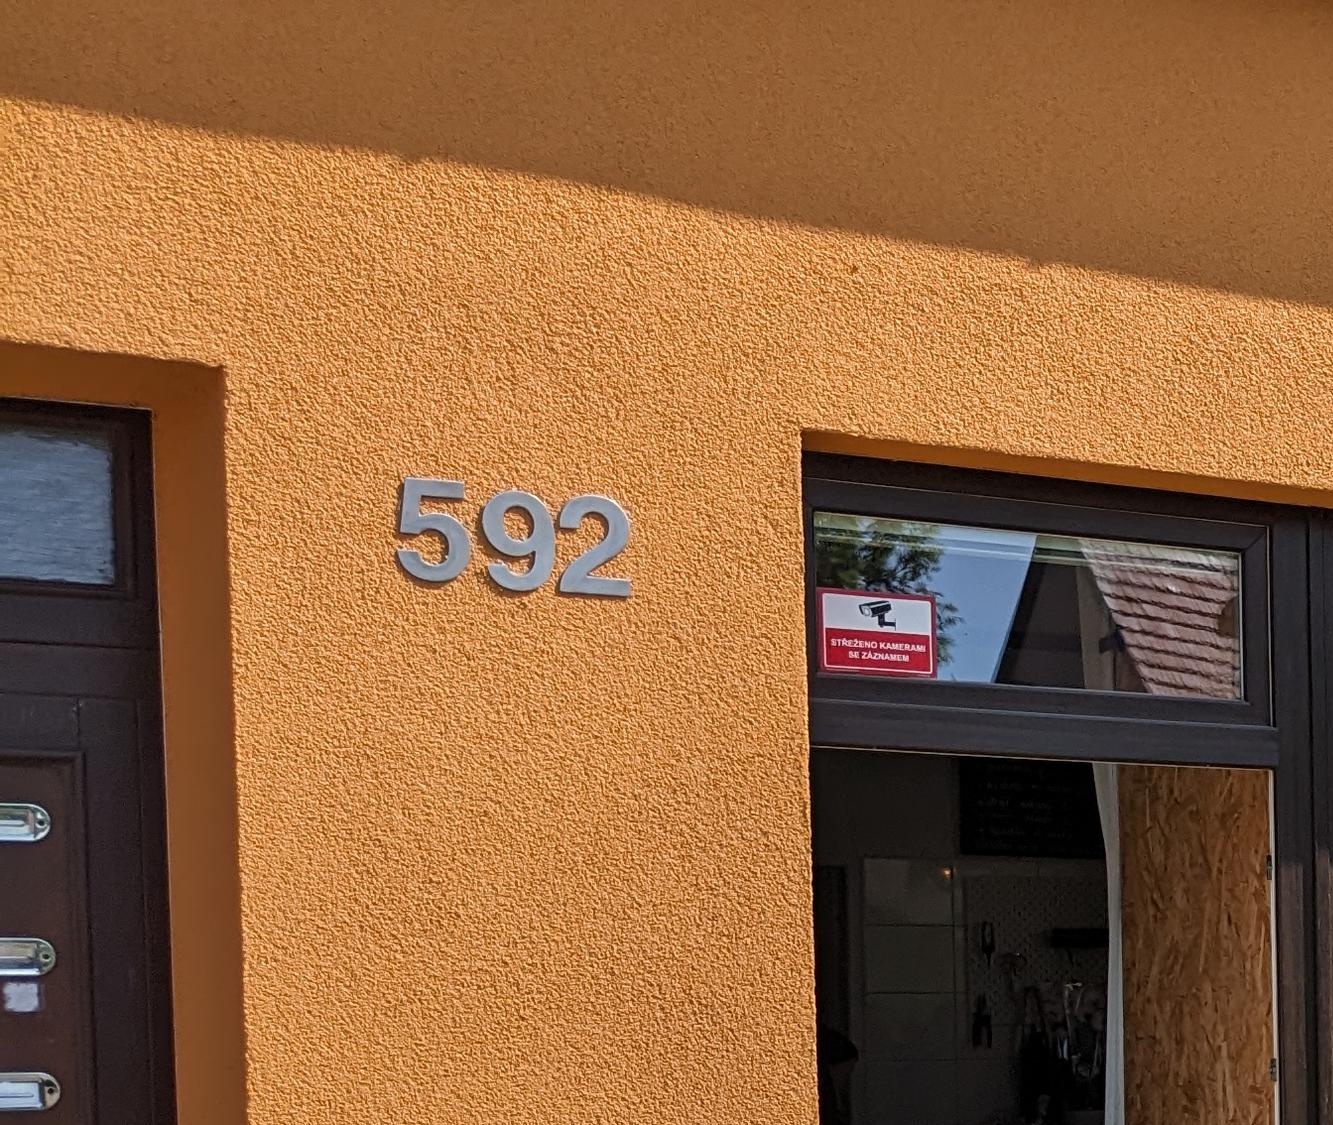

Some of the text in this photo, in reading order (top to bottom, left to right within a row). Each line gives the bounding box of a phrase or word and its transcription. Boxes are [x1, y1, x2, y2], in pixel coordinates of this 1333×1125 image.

[397, 476, 632, 597] 592
[880, 641, 926, 653] KAMERAMI
[848, 650, 860, 659] SE
